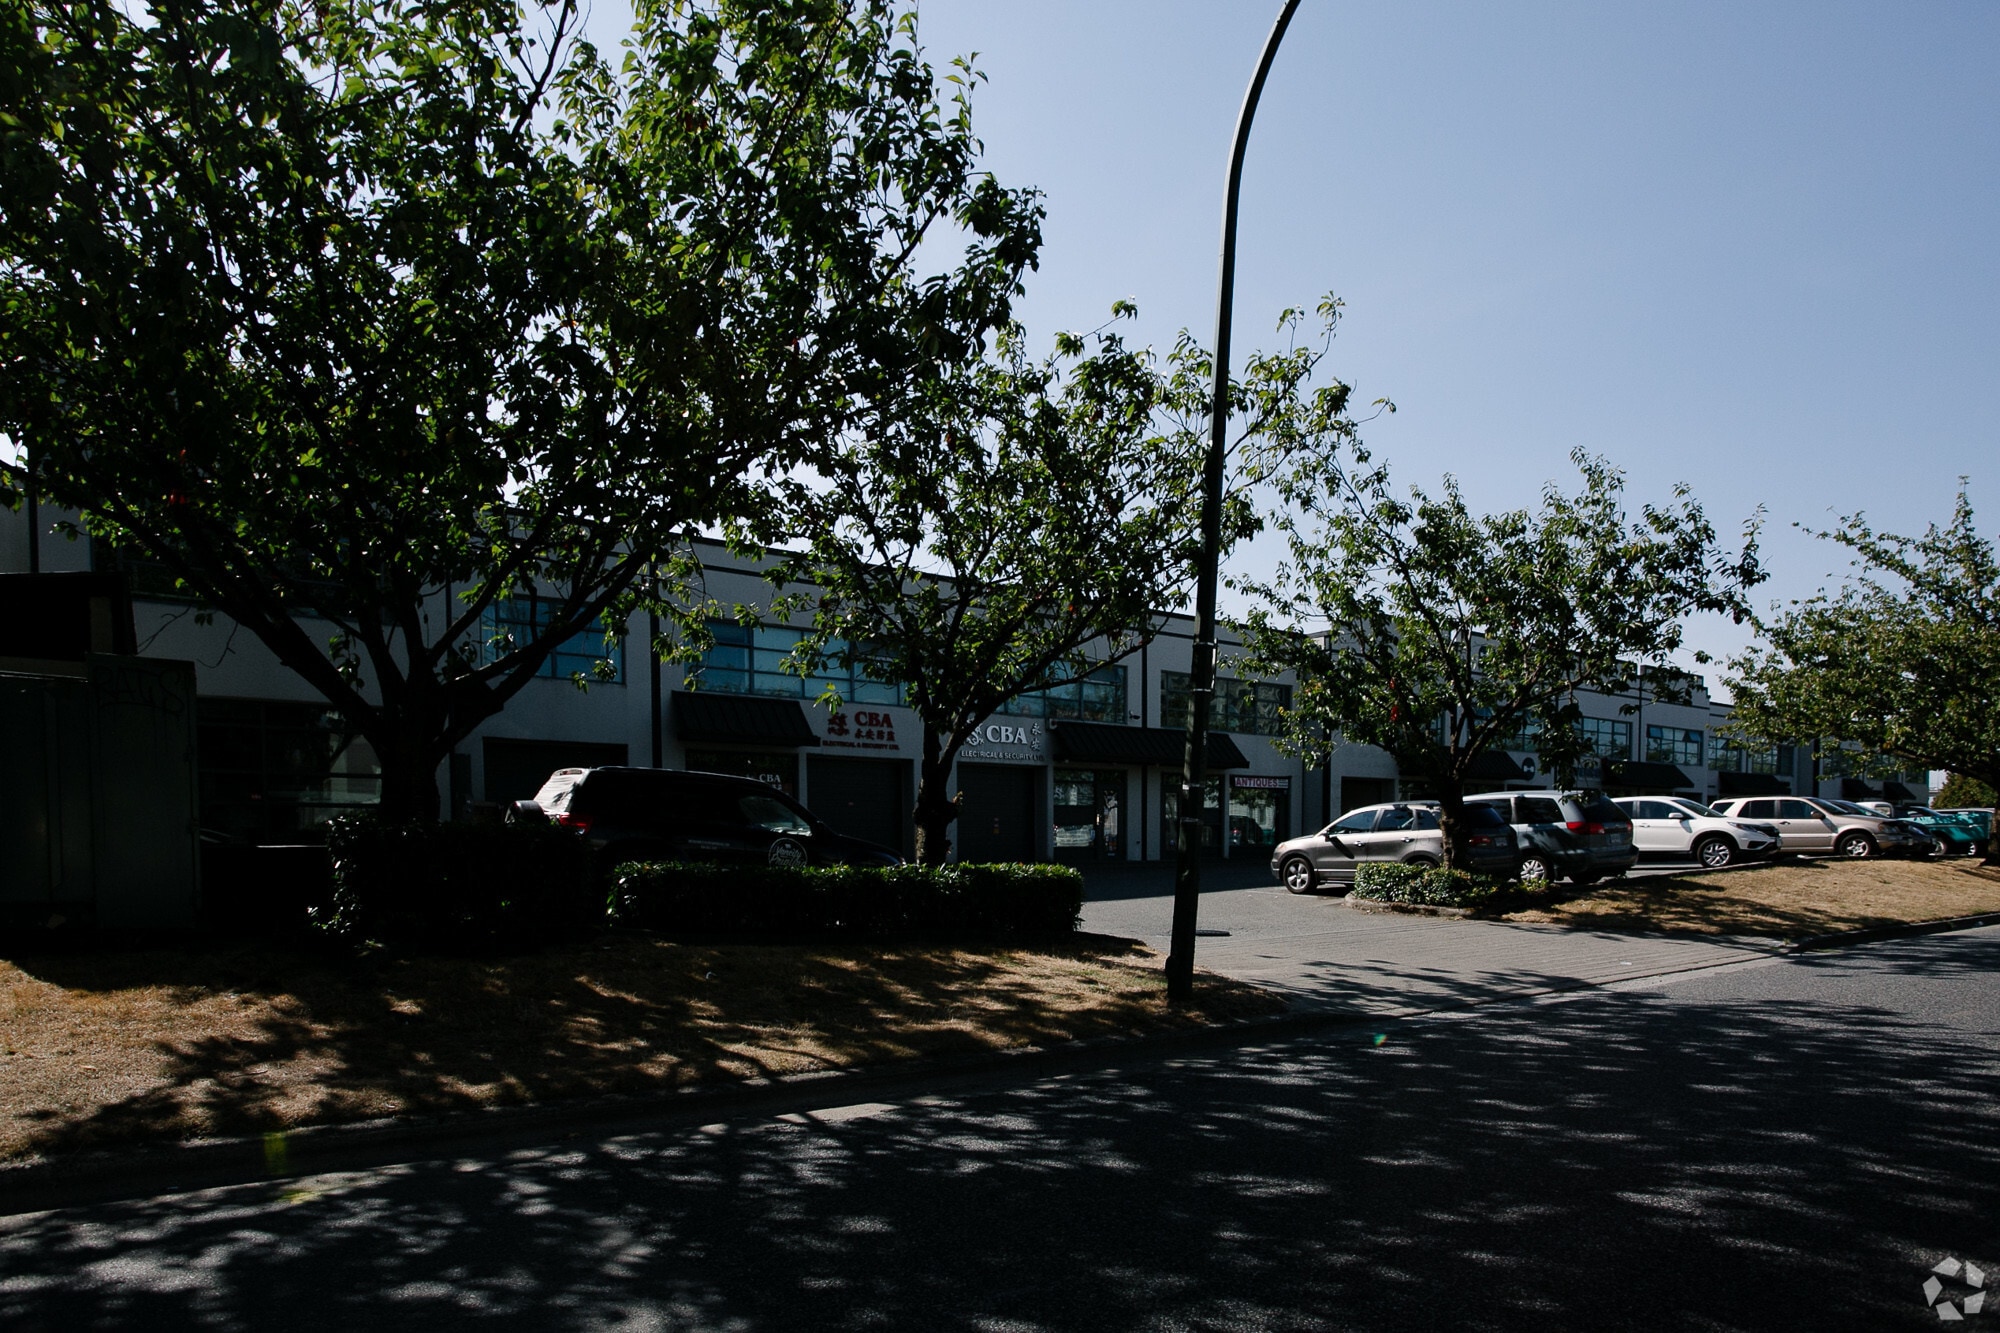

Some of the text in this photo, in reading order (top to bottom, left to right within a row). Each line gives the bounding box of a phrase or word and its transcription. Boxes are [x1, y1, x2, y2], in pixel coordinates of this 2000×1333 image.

[855, 711, 893, 728] CBA
[986, 725, 1028, 743] CBA
[961, 750, 998, 759] ELECTRICAL
[1004, 752, 1033, 761] SECURITY
[759, 773, 781, 783] CBA
[1236, 777, 1278, 787] ANTIQUES
